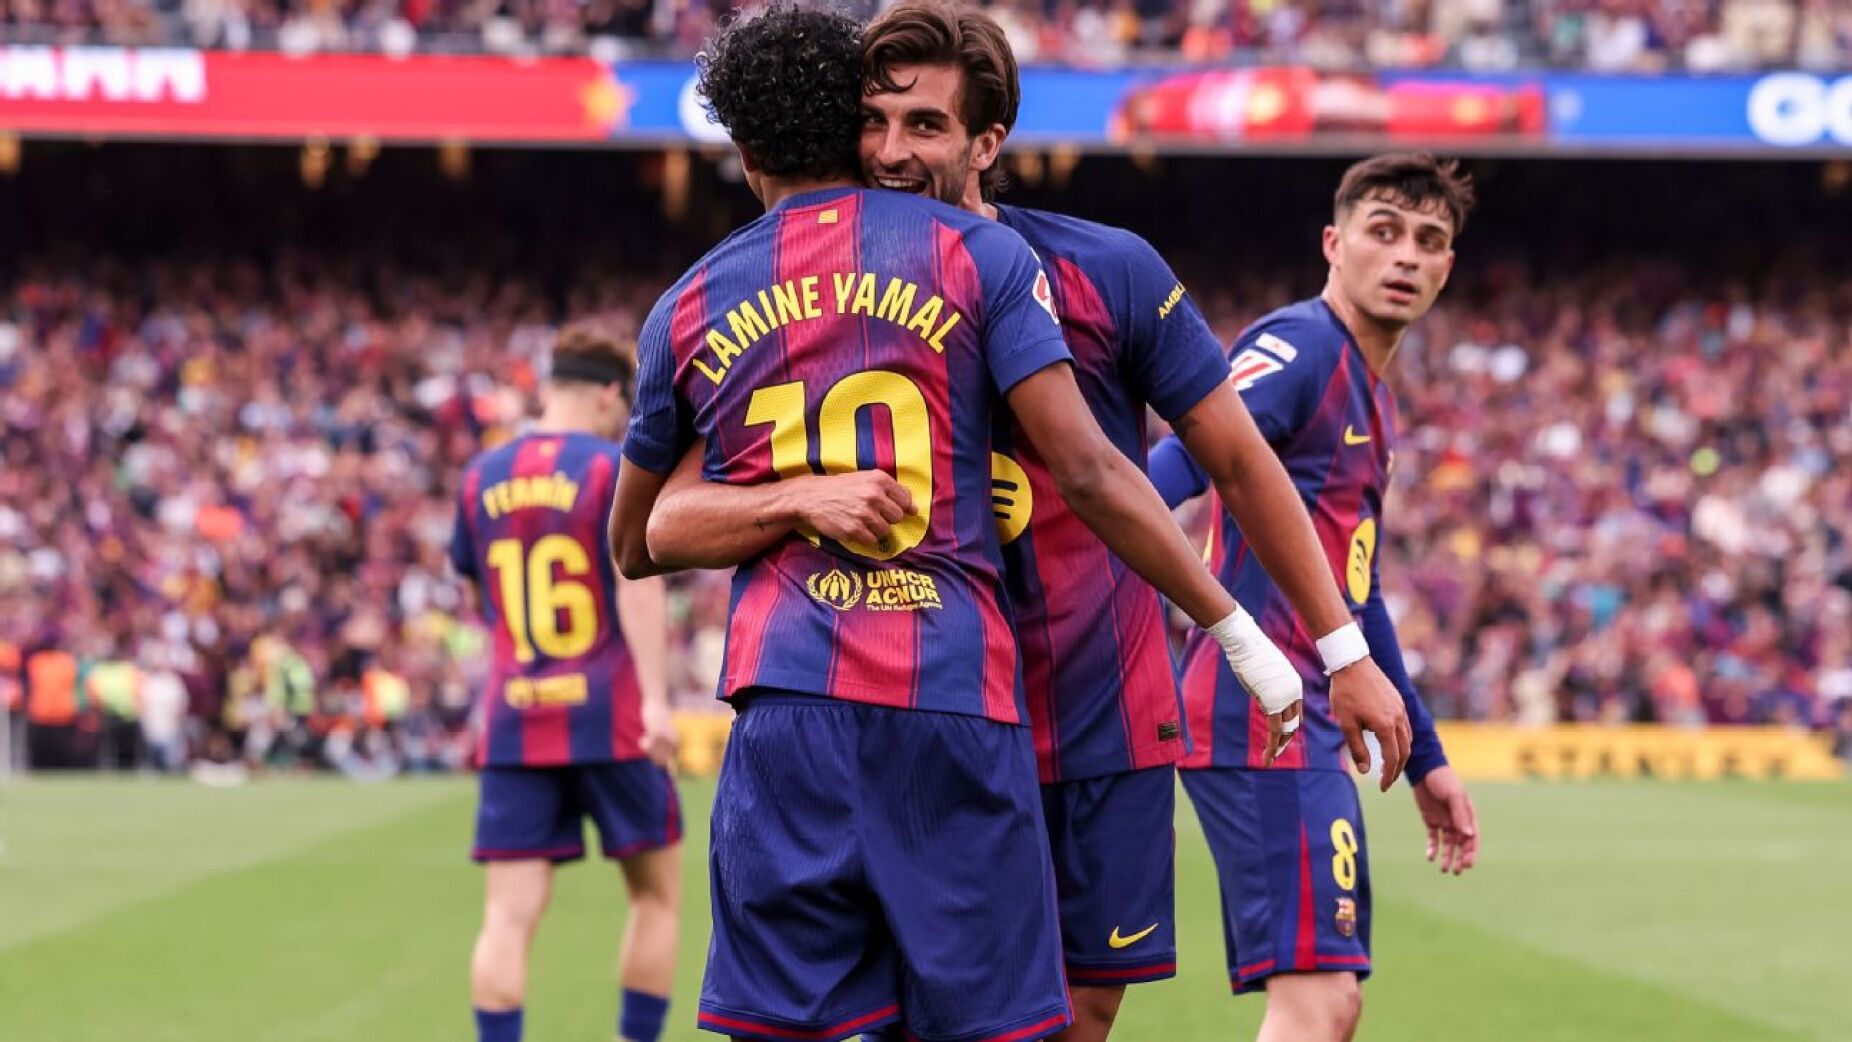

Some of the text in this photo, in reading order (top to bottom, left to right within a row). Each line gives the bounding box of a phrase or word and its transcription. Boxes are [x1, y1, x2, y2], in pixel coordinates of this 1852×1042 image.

[692, 272, 961, 386] LAMINE YAMAL
[744, 370, 933, 561] 10
[487, 533, 599, 664] 16
[866, 569, 935, 588] UNHCR
[866, 586, 941, 603] ACNUR
[1329, 818, 1358, 891] 8
